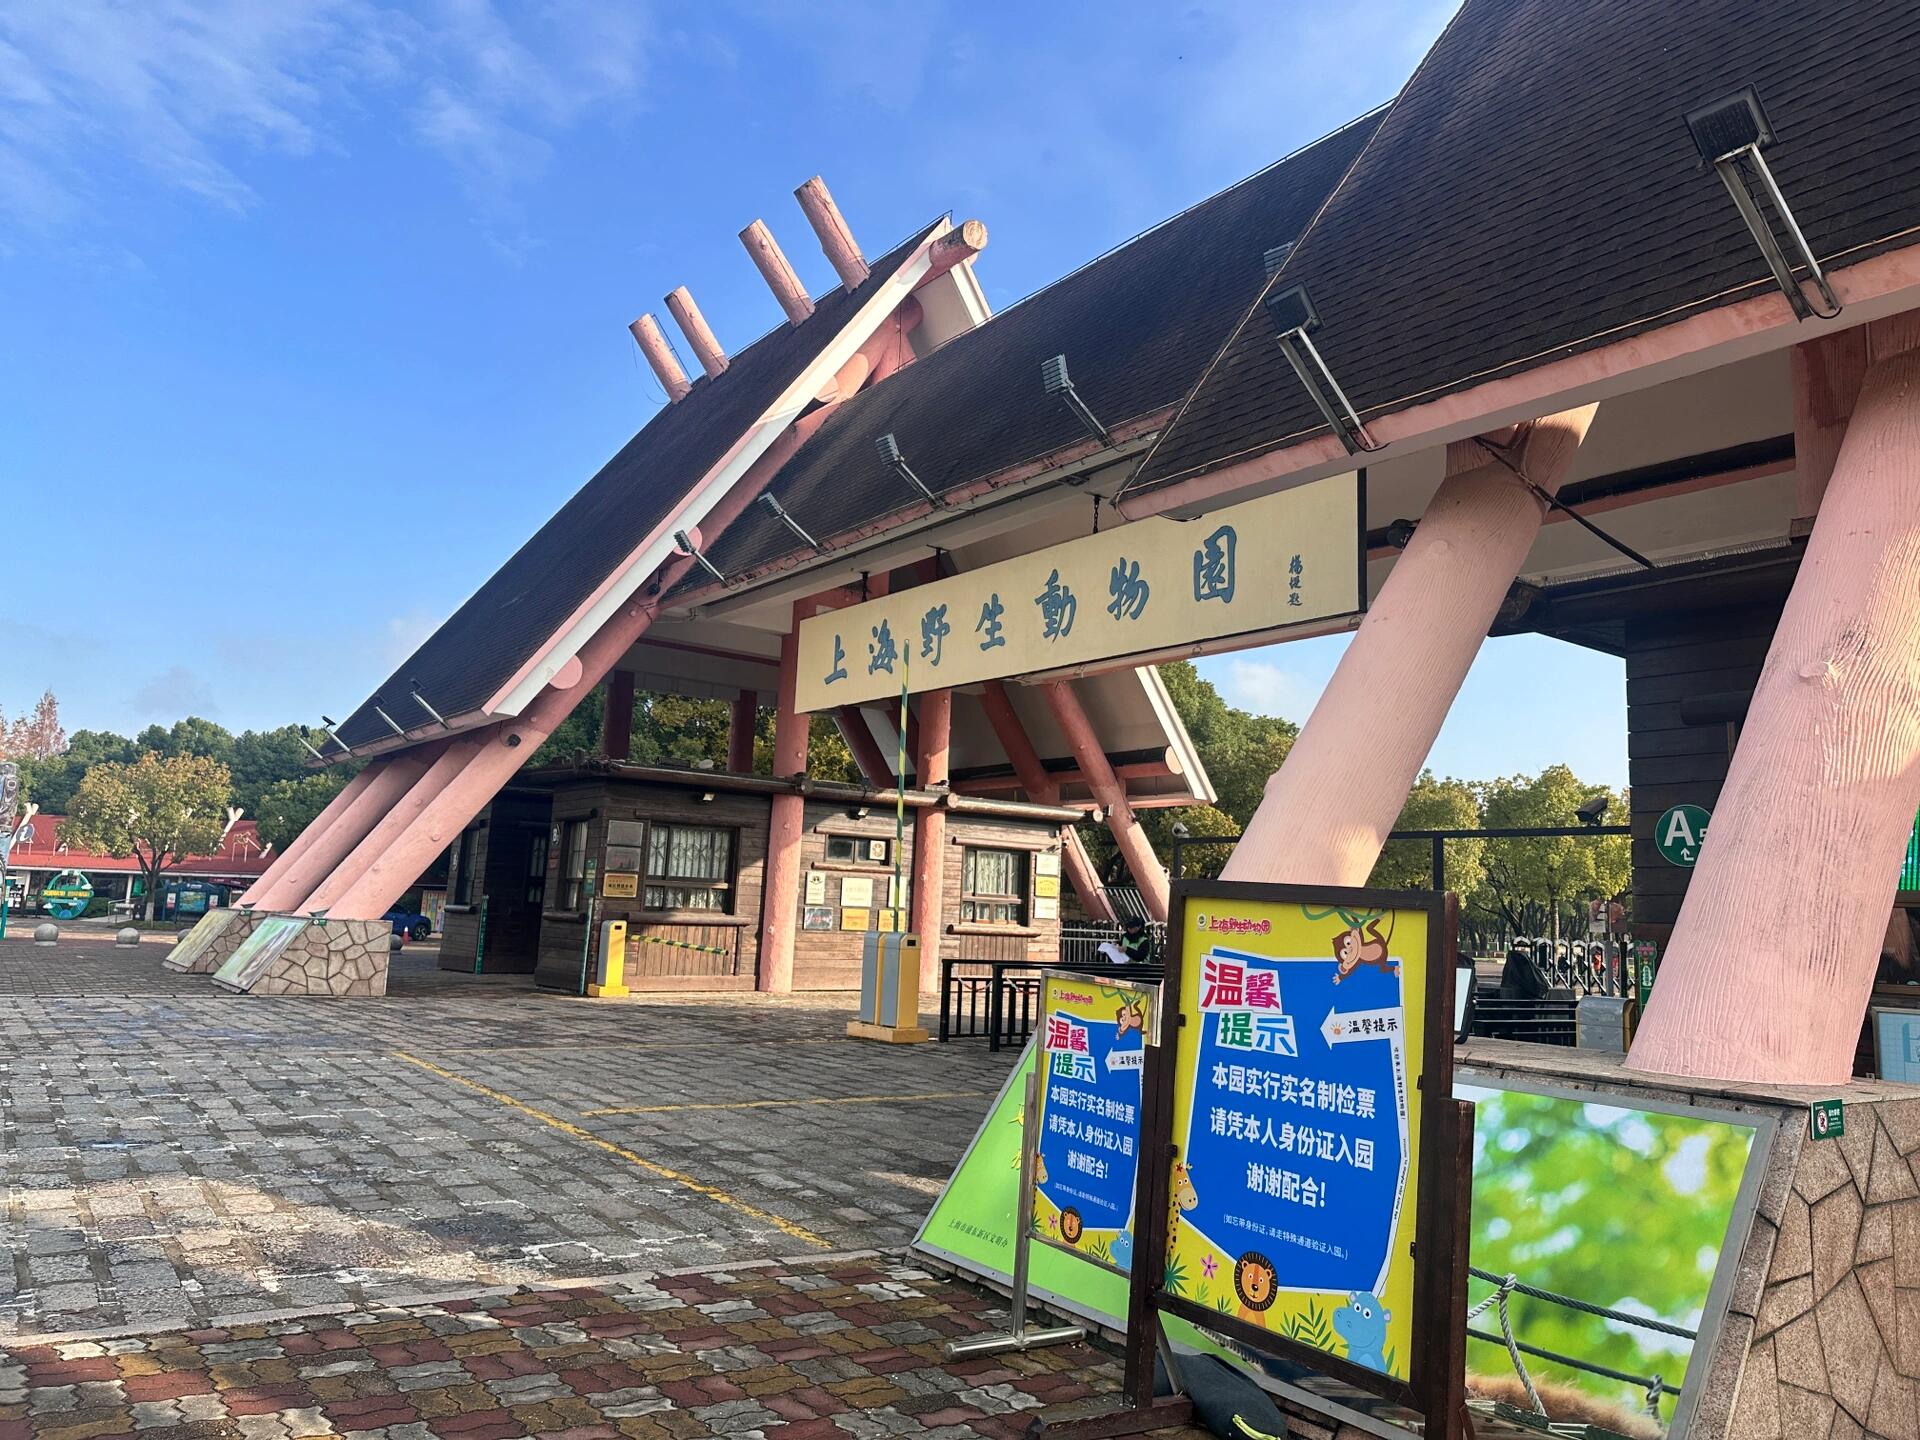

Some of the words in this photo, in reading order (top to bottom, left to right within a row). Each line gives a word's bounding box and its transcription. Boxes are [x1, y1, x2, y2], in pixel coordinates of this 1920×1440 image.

[823, 525, 1238, 686] 上海野生動物園
[1201, 959, 1280, 1009] 温馨
[1046, 1017, 1088, 1052] 温馨
[1221, 1013, 1295, 1054] 提示
[1348, 1018, 1398, 1034] 温馨提示
[1056, 1053, 1095, 1082] 提示
[1050, 1084, 1135, 1125] 本园实行实名制检票
[1211, 1061, 1376, 1120] 本园实行实名制检票
[1049, 1113, 1134, 1157] 请凭本人身份证入园
[1210, 1106, 1374, 1172] 请凭本人身份证入园
[1067, 1149, 1109, 1179] 谢谢配合!
[1246, 1161, 1326, 1208] 谢谢配合!
